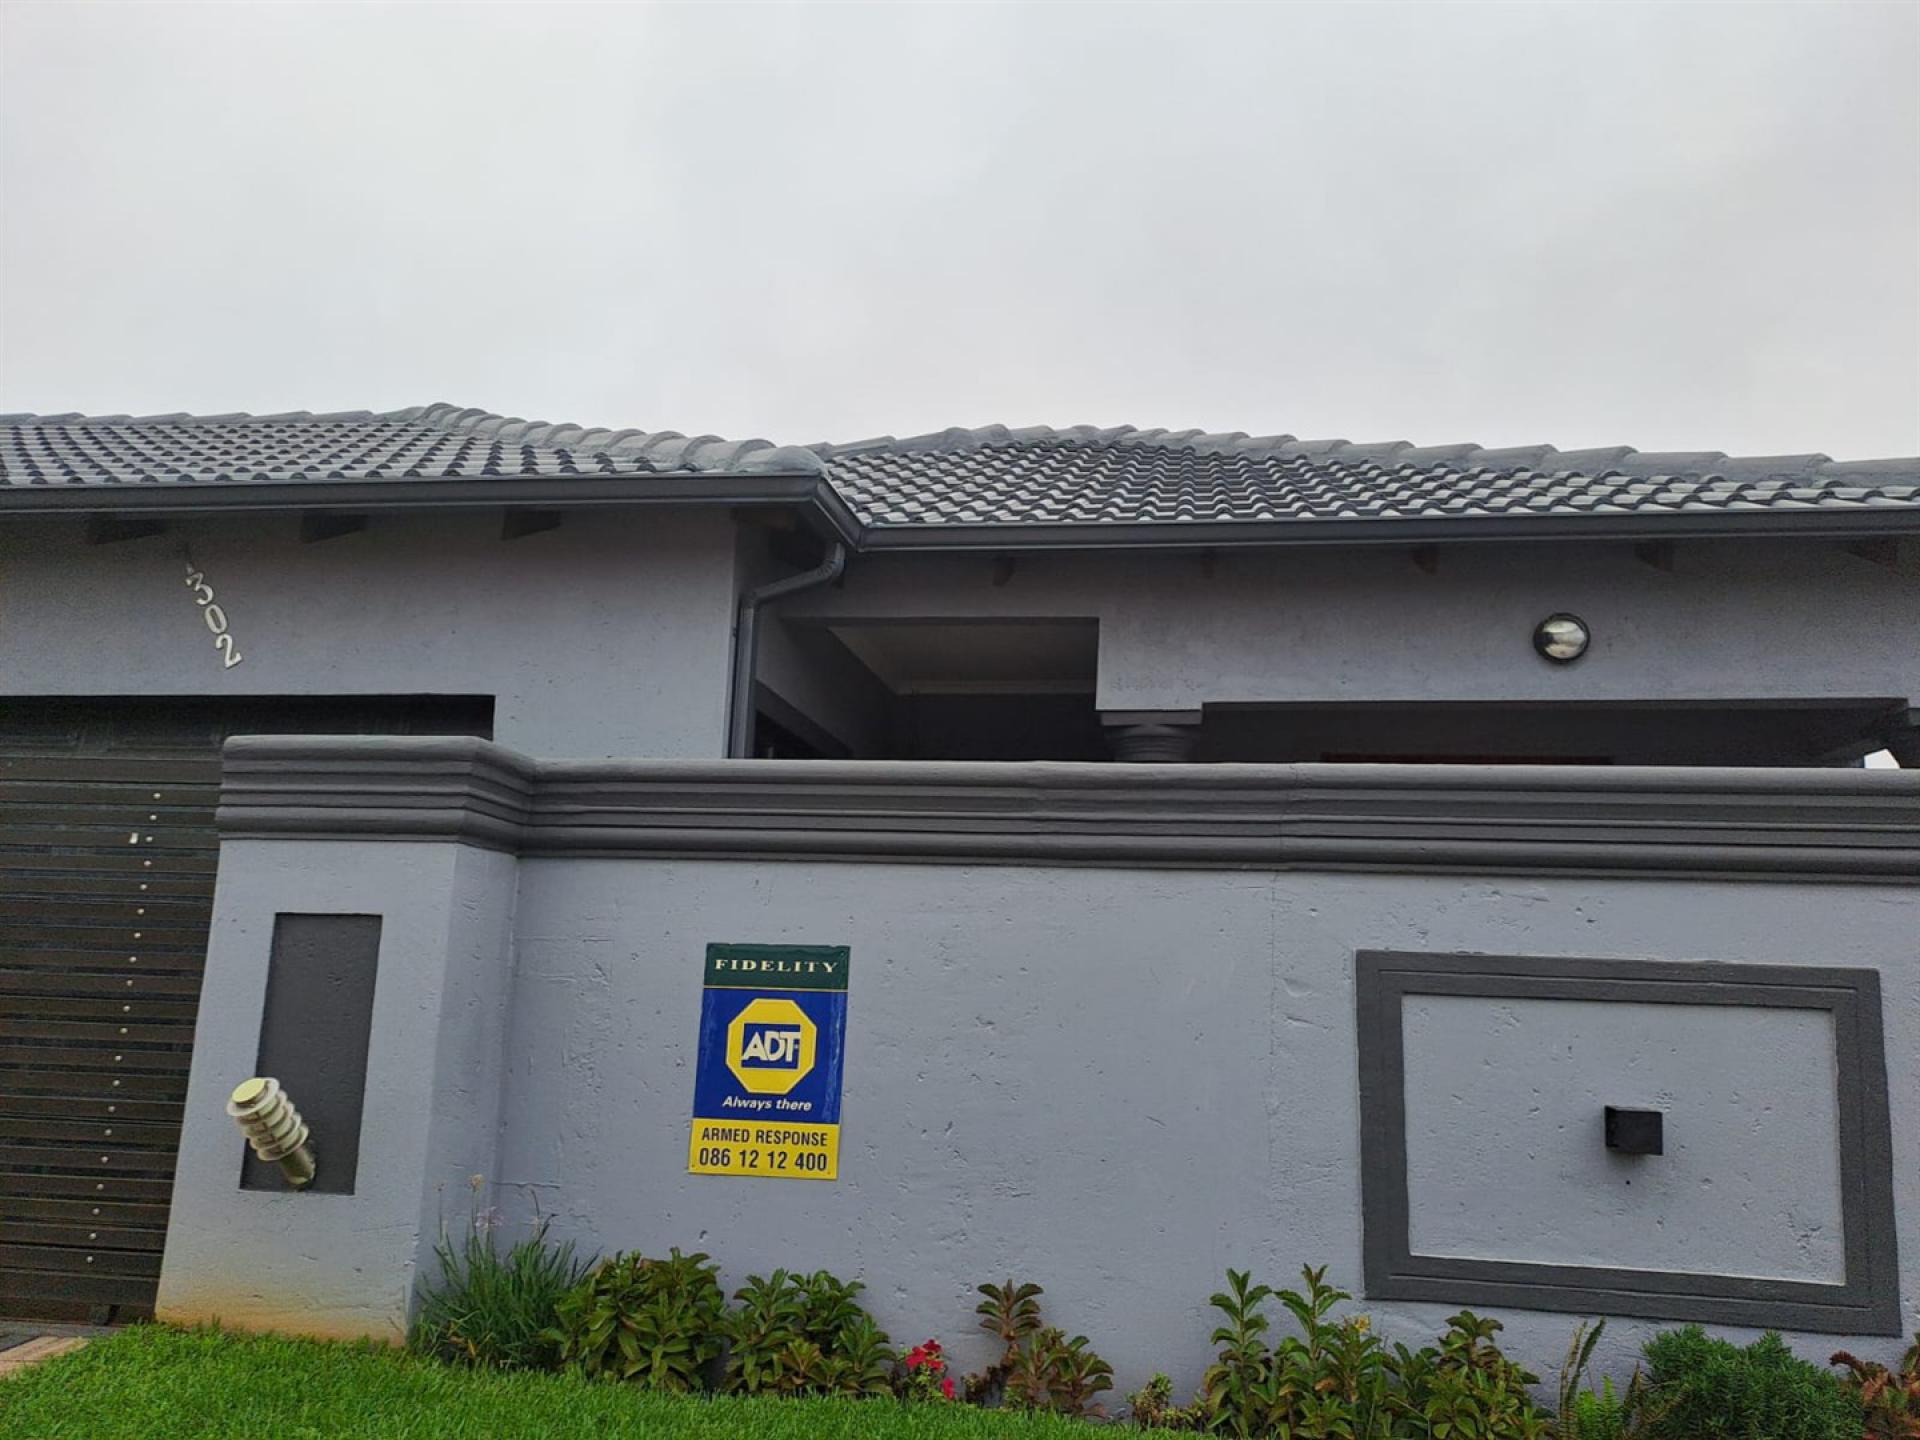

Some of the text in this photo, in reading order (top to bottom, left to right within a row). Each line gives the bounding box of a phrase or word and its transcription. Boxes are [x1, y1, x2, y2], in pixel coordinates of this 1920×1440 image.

[715, 959, 838, 973] FIDELITY
[741, 1031, 801, 1062] ADT
[722, 1095, 812, 1112] Always there
[701, 1127, 827, 1146] ARMED RESPONSE
[699, 1147, 828, 1171] 086 12 12 400
